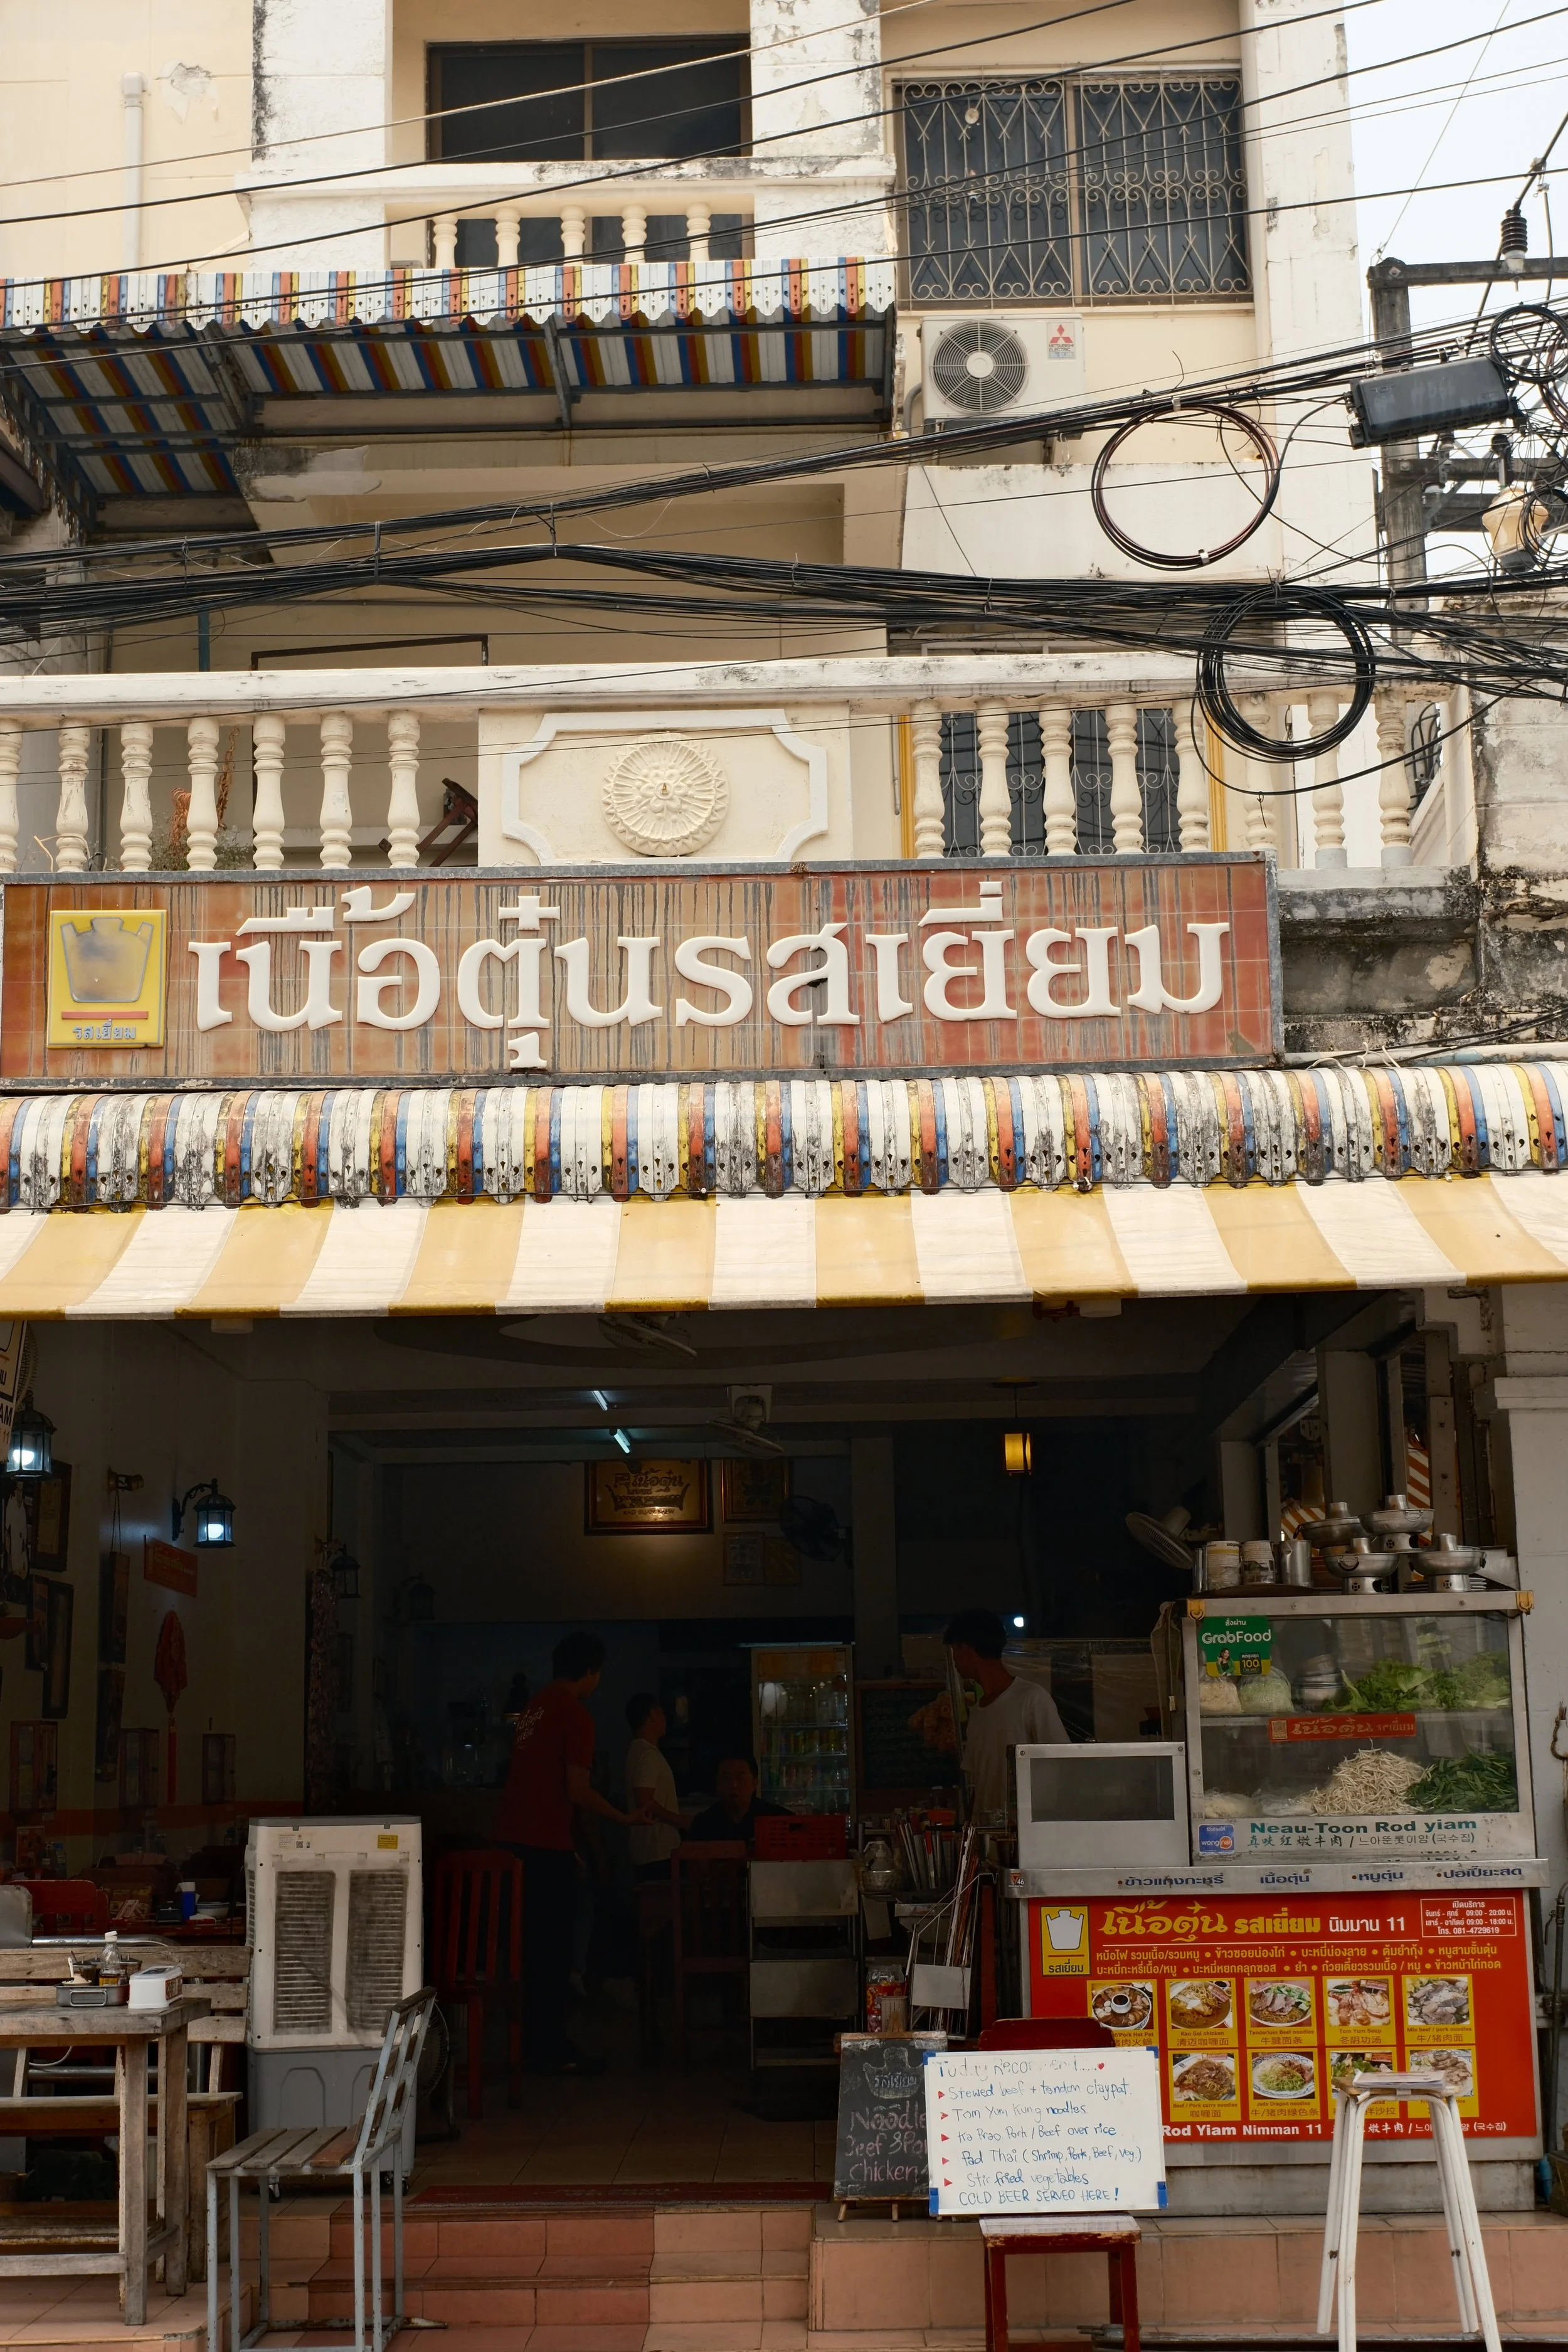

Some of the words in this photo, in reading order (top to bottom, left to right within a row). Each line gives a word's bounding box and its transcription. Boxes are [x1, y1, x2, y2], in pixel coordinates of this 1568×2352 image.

[73, 1019, 136, 1040] รสเยี่ยม
[1225, 1618, 1246, 1626] สั่งผ่าน
[1202, 1629, 1271, 1644] GrabFood
[1291, 1717, 1374, 1737] เนื้อตุ๋น
[1250, 1822, 1368, 1834] Neau-Toon
[1375, 1821, 1416, 1833] Rod
[1424, 1819, 1476, 1833] yiam
[1260, 1871, 1310, 1885] เนื้อตุ๋น
[1359, 1869, 1404, 1883] หมูตุ๋น
[1098, 1899, 1228, 1942] เนื้อตุ๋น
[1234, 1907, 1321, 1934] รสเยี่ยม
[1329, 1917, 1380, 1932] นิมมาน
[1387, 1917, 1406, 1931] 11
[1425, 1909, 1441, 1917] จันทร์
[1446, 1909, 1459, 1919] ศุกร์
[1426, 1918, 1439, 1926] เสาร์
[1444, 1918, 1465, 1926] อาทิตย์
[1096, 1949, 1128, 1961] หม้อไฟ
[1131, 1947, 1200, 1963] รวมเนื้อ/รวมหมู
[1216, 1946, 1285, 1959] ข้าวซอยน่องไก่
[1301, 1943, 1367, 1957] บะหมี่น่องลาย
[1382, 1944, 1422, 1959] ต้มยำกุ้ง
[1439, 1941, 1497, 1959] หมูสามชั้นตุ๋น
[1048, 1959, 1084, 1973] รสเยี่ยม
[1097, 1961, 1177, 1976] บะหมี่กะหรี่เนื้อ/หมู
[1193, 1961, 1276, 1976] บะหมี่หยกคลุกซอส
[1295, 1963, 1307, 1972] ยำ
[1407, 1961, 1421, 1973] หมู
[1435, 1959, 1501, 1970] ข้าวหน้าไก่ทอด
[948, 2083, 993, 2099] Stewed
[1000, 2080, 1025, 2096] beef
[1040, 2079, 1081, 2096] tendon
[951, 2108, 981, 2120] Tom
[985, 2106, 1007, 2119] Yum
[1013, 2103, 1042, 2122] Kung
[958, 2131, 973, 2143] Ka
[977, 2128, 1001, 2141] Prao
[1005, 2126, 1027, 2139] Pork
[1038, 2124, 1061, 2137] Beef
[1067, 2126, 1090, 2135] over
[1093, 2123, 1118, 2136] rice
[1162, 2124, 1191, 2136] Rod
[1197, 2124, 1237, 2136] Yiam
[1242, 2124, 1300, 2136] Nimman
[1306, 2124, 1322, 2134] 11
[961, 2150, 983, 2167] Pad
[989, 2148, 1018, 2163] Thai
[849, 2158, 918, 2183] Chicken
[968, 2173, 990, 2188] Stir
[994, 2168, 1025, 2184] fried
[1030, 2166, 1089, 2191] vegetables
[959, 2191, 992, 2206] COLD
[999, 2190, 1030, 2203] BEER
[1081, 2190, 1111, 2201] HERE
